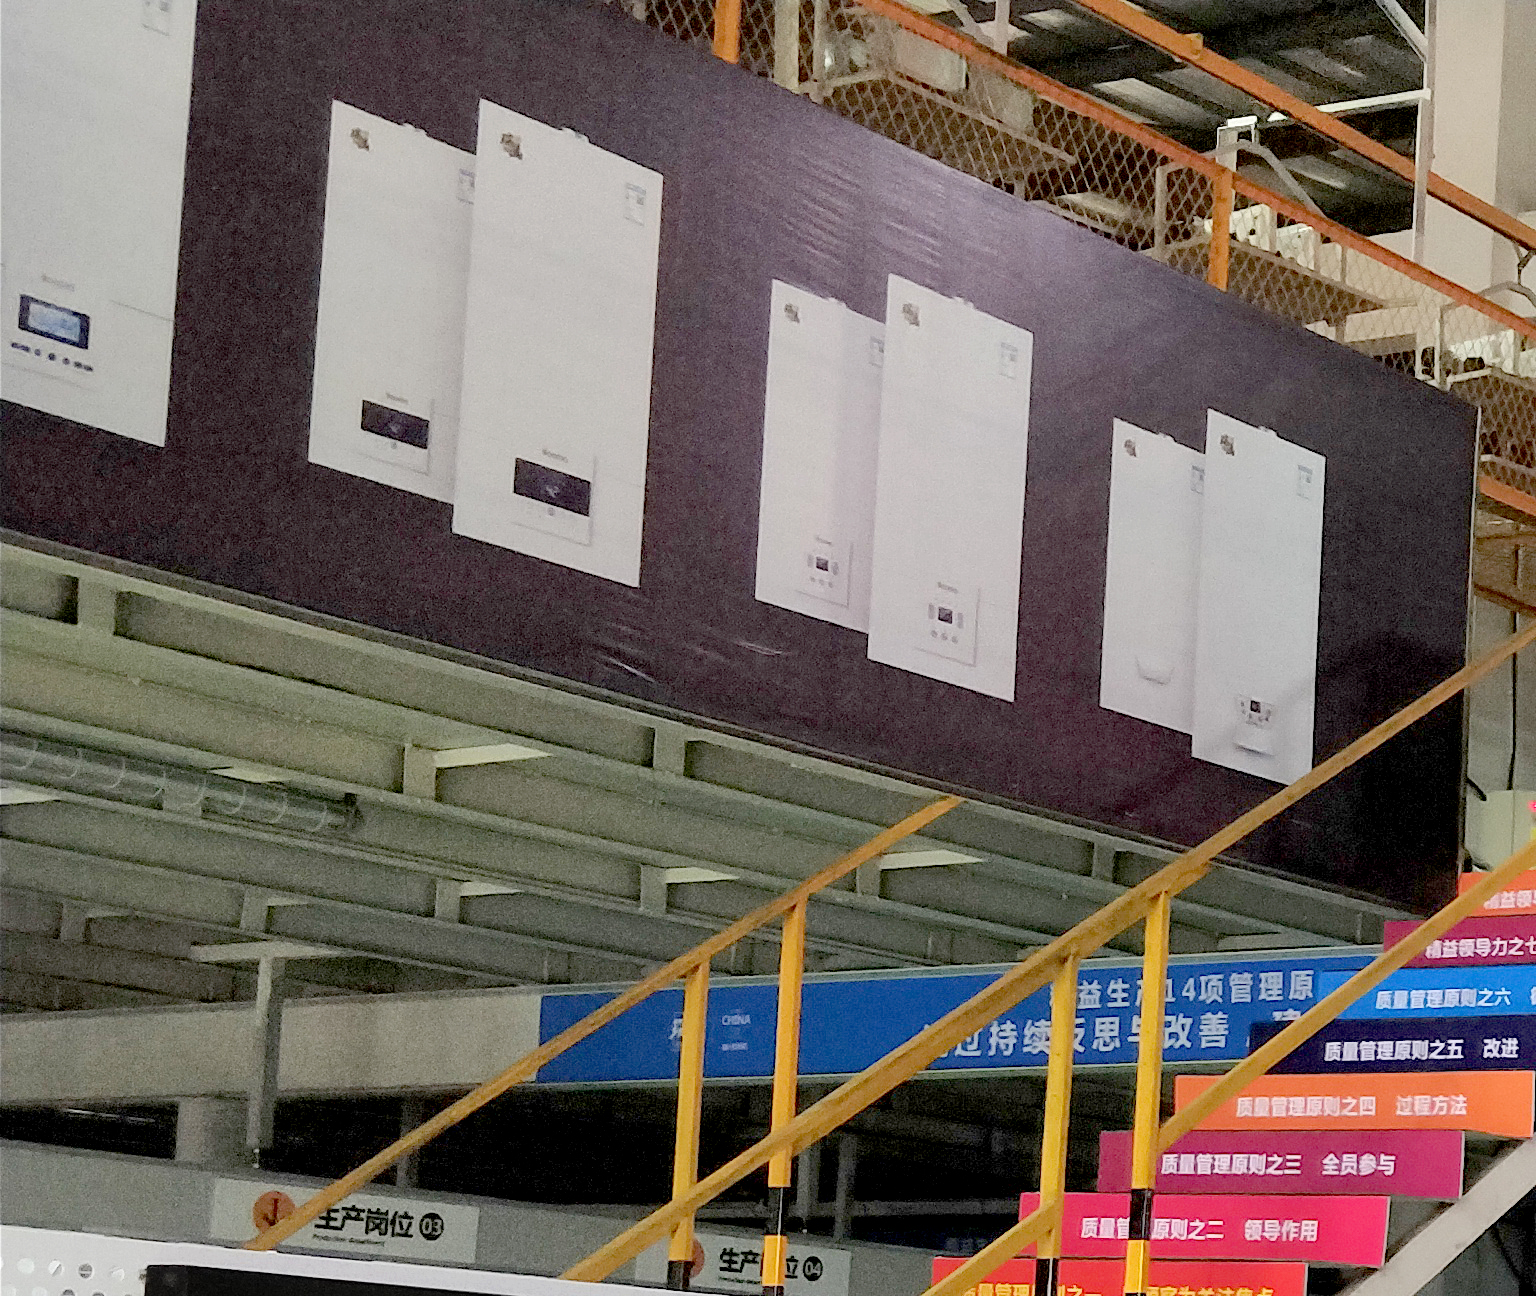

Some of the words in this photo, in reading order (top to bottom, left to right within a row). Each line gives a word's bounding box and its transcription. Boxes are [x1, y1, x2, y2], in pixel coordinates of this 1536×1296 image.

[1376, 987, 1511, 1010] 质量管理原则之六
[1324, 1038, 1464, 1062] 质量管理原则之五
[1483, 1037, 1519, 1059] 改进
[1236, 1096, 1376, 1118] 质量管理原则之四
[1396, 1095, 1468, 1116] 过程方法
[1161, 1153, 1302, 1176] 质量管理原则之三
[1322, 1153, 1396, 1177] 全员参与
[315, 1205, 414, 1238] 生产岗位
[1081, 1218, 1224, 1242] 质量管原则之二
[1244, 1219, 1318, 1243] 领导作用
[719, 1248, 798, 1279] 生产位
